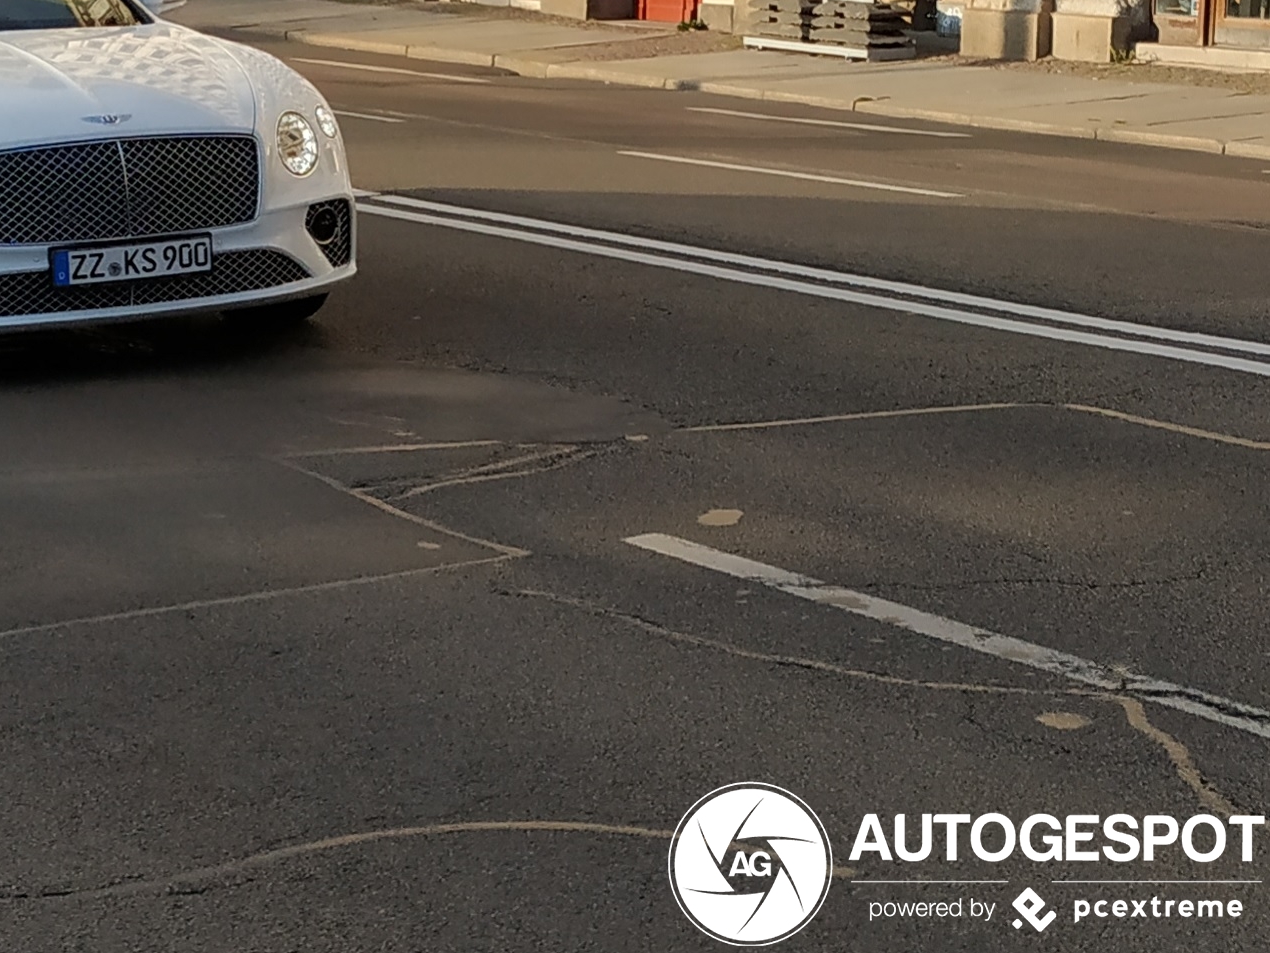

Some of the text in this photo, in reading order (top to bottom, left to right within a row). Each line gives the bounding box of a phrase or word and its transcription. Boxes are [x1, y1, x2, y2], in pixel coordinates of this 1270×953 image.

[71, 253, 105, 280] ZZ
[124, 248, 157, 275] KS
[163, 242, 208, 271] 900
